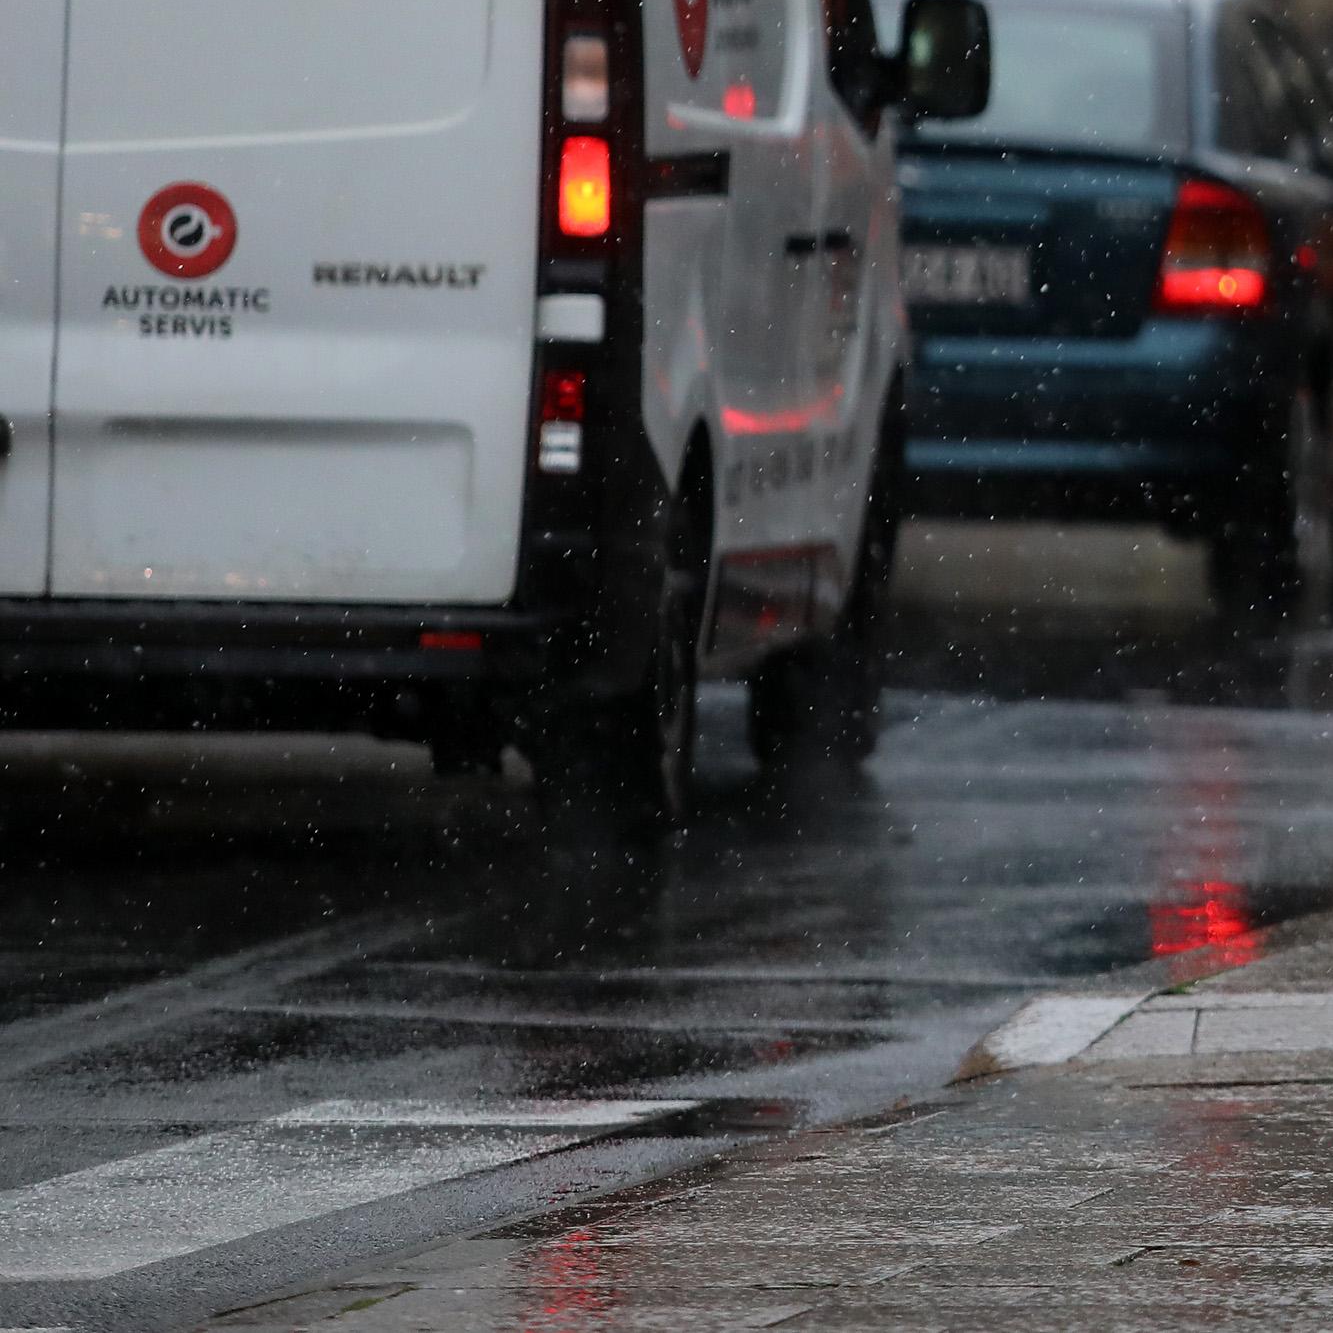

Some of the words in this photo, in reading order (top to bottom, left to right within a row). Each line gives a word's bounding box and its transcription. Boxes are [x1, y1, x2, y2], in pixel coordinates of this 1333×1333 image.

[313, 263, 486, 288] RENAULT
[103, 286, 271, 312] AUTOMATIC
[139, 314, 233, 338] SERVIS
